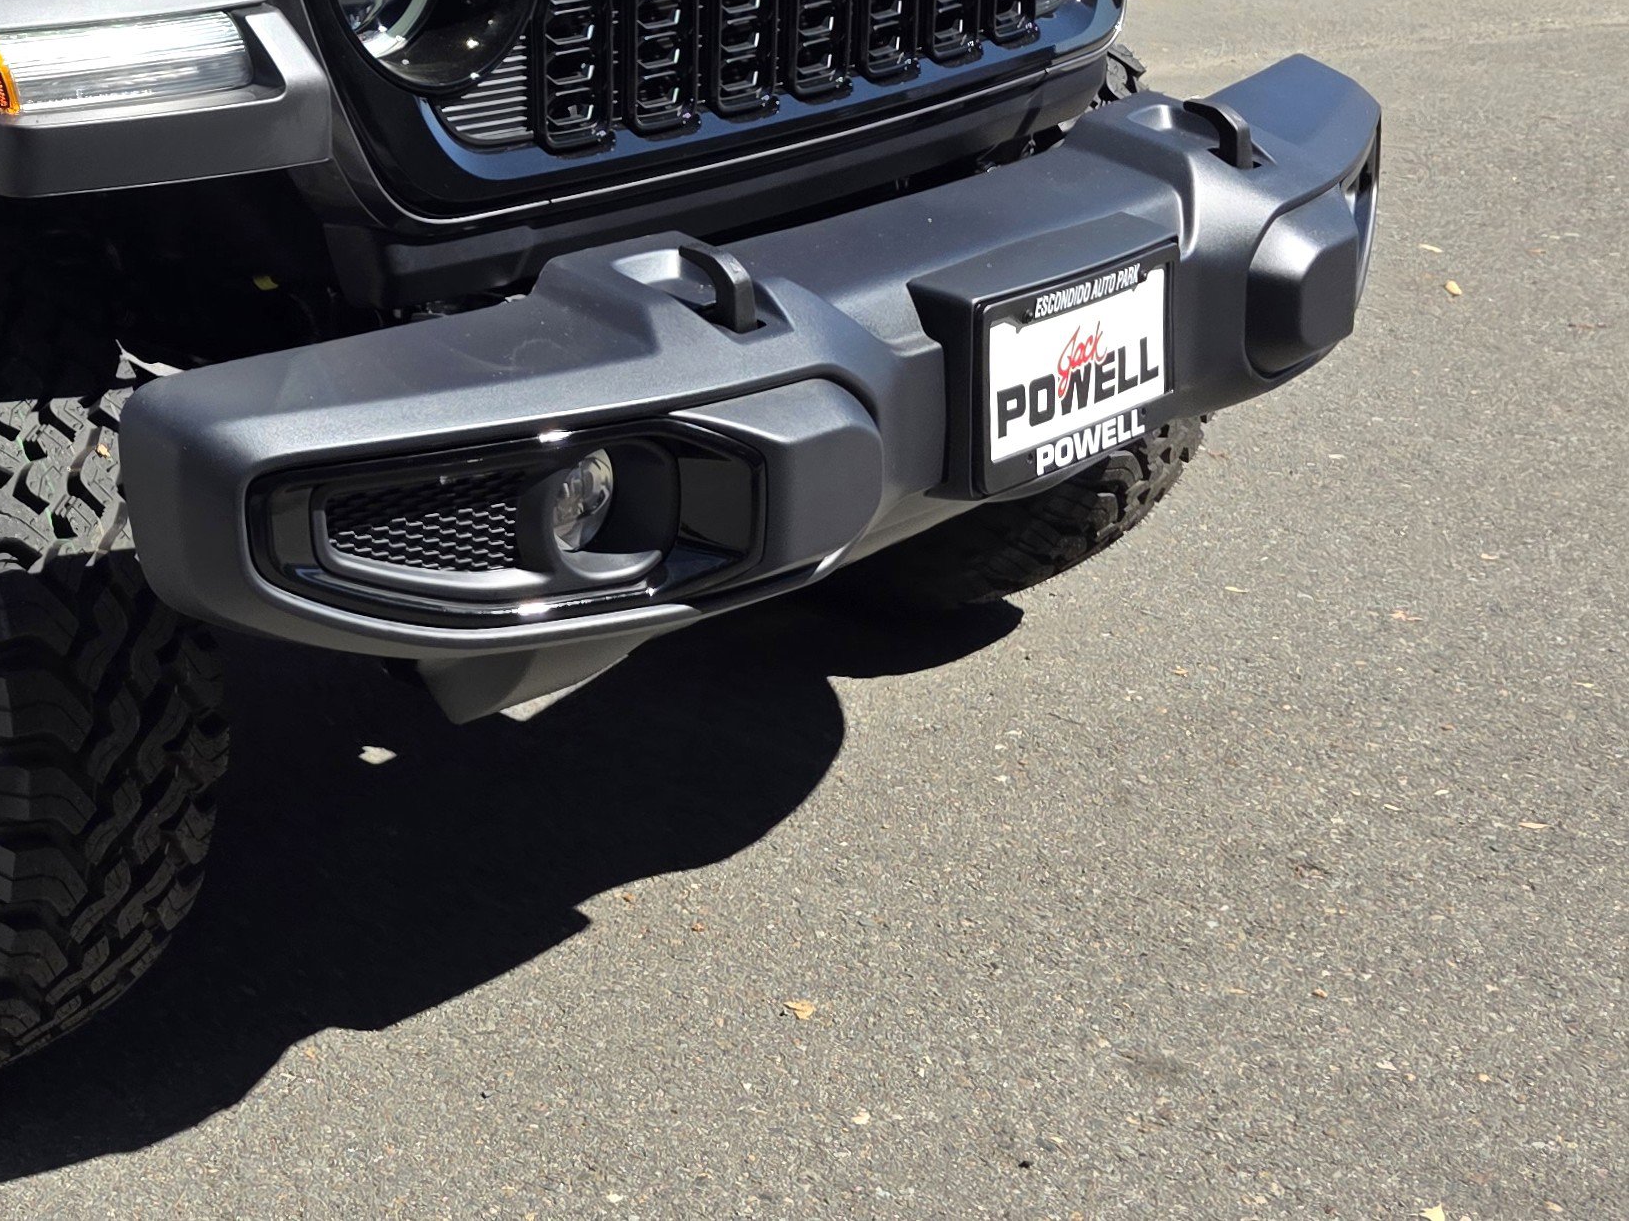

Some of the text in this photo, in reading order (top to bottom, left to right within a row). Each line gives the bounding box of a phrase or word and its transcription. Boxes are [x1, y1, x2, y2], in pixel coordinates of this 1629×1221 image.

[1034, 262, 1141, 319] ESCONDIDO AUTO PARK
[996, 336, 1160, 440] POWELL
[1056, 320, 1108, 398] Jack
[1036, 408, 1146, 476] POWELL
